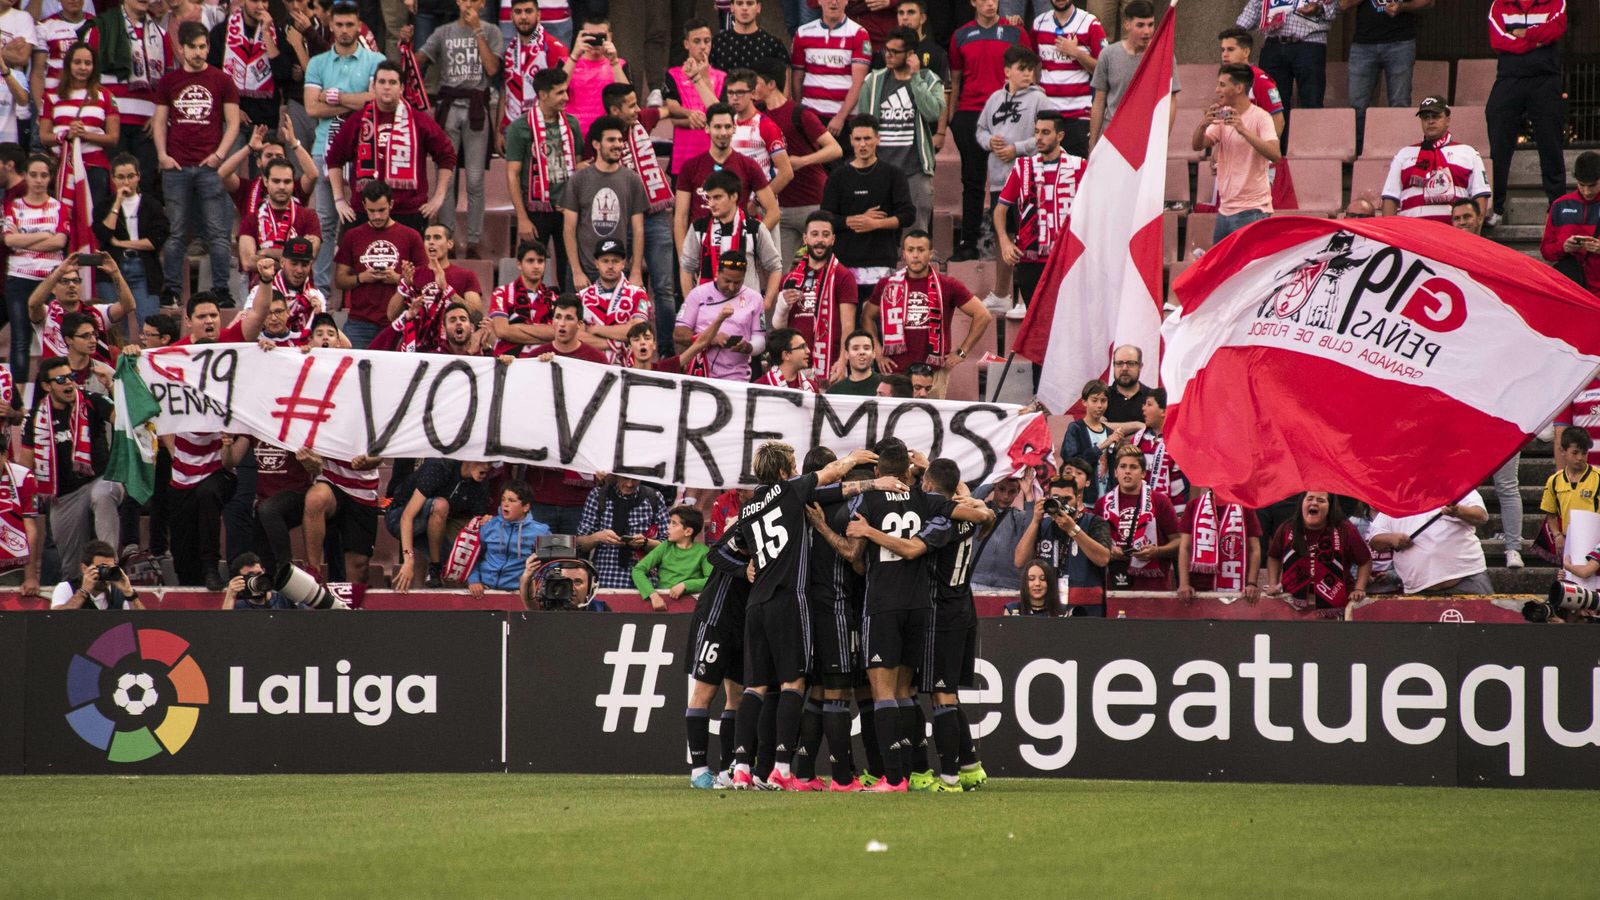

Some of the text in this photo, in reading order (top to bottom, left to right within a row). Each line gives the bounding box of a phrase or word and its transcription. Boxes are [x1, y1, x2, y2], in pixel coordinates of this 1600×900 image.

[810, 54, 844, 64] SLVER
[880, 107, 915, 119] adidas
[885, 307, 903, 340] LA
[147, 348, 238, 426] G19
[271, 355, 1008, 487] #VOLVEREMOS
[263, 457, 277, 465] GCF
[885, 490, 910, 501] DALO
[751, 506, 789, 570] 15
[1216, 560, 1241, 593] LA
[699, 640, 719, 663] 16
[229, 660, 437, 726] LaLiga
[595, 623, 1600, 777] #egeatuequ
